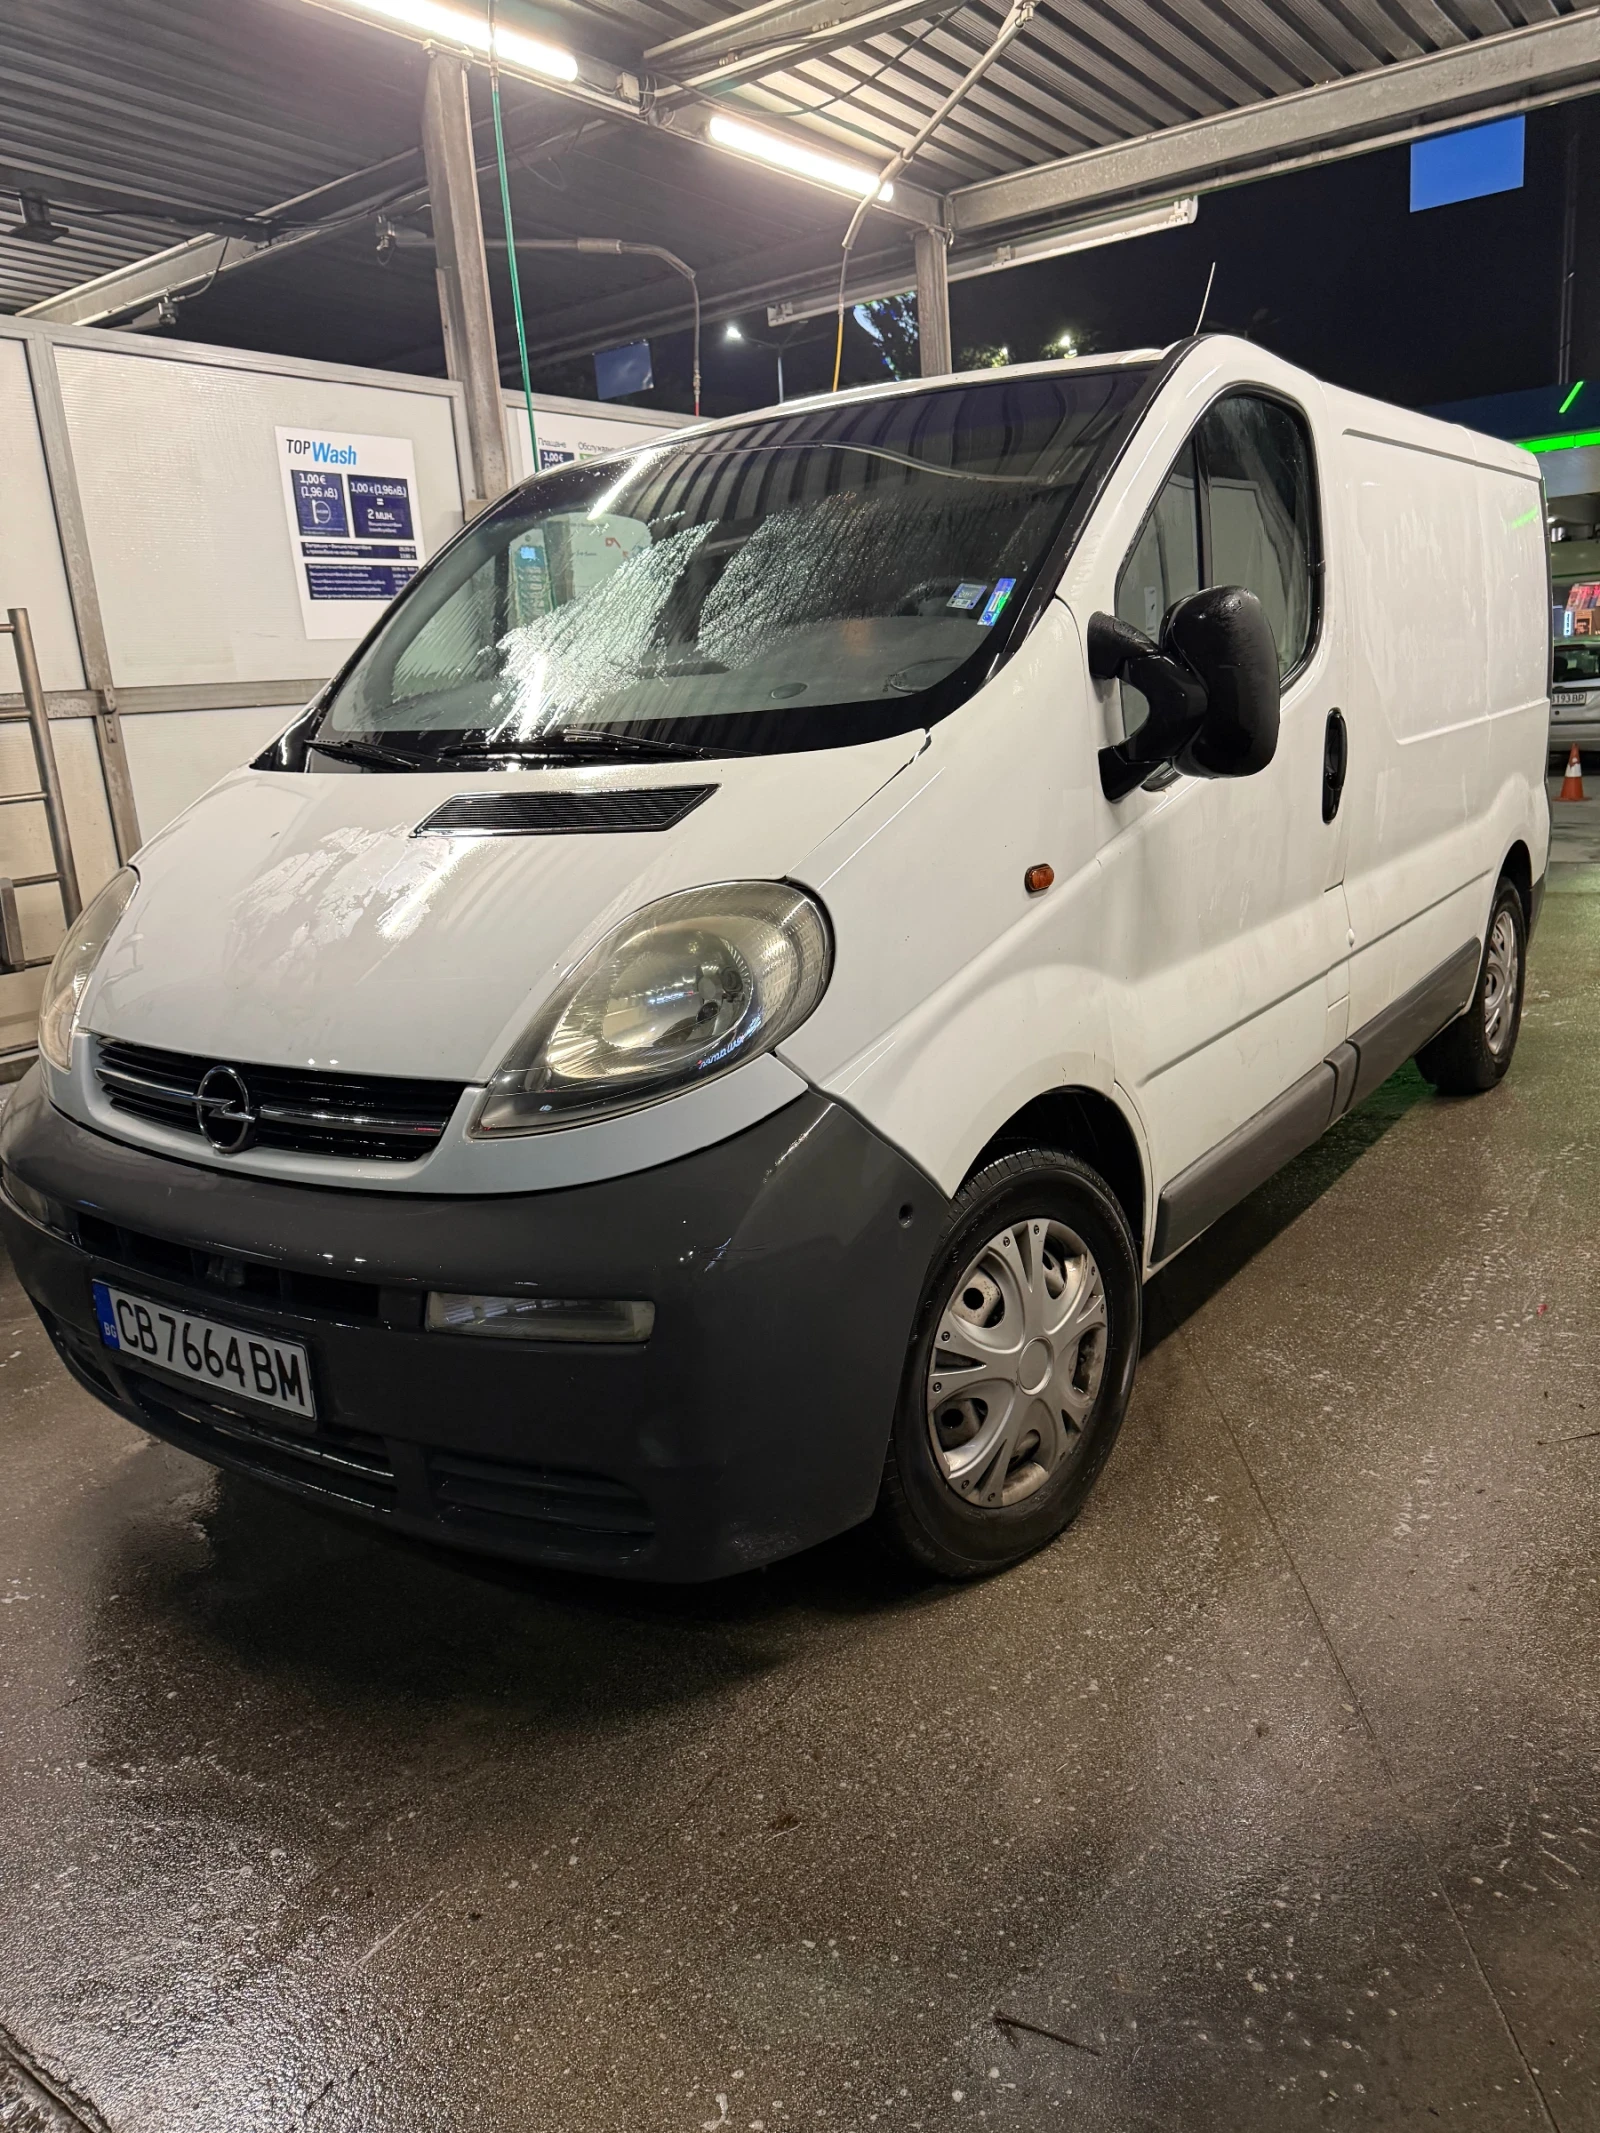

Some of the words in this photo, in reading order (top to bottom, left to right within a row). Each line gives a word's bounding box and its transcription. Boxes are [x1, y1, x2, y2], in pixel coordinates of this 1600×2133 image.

[286, 438, 311, 455] TOP
[311, 441, 357, 466] Wash
[367, 508, 375, 519] 2
[103, 1321, 117, 1339] BG
